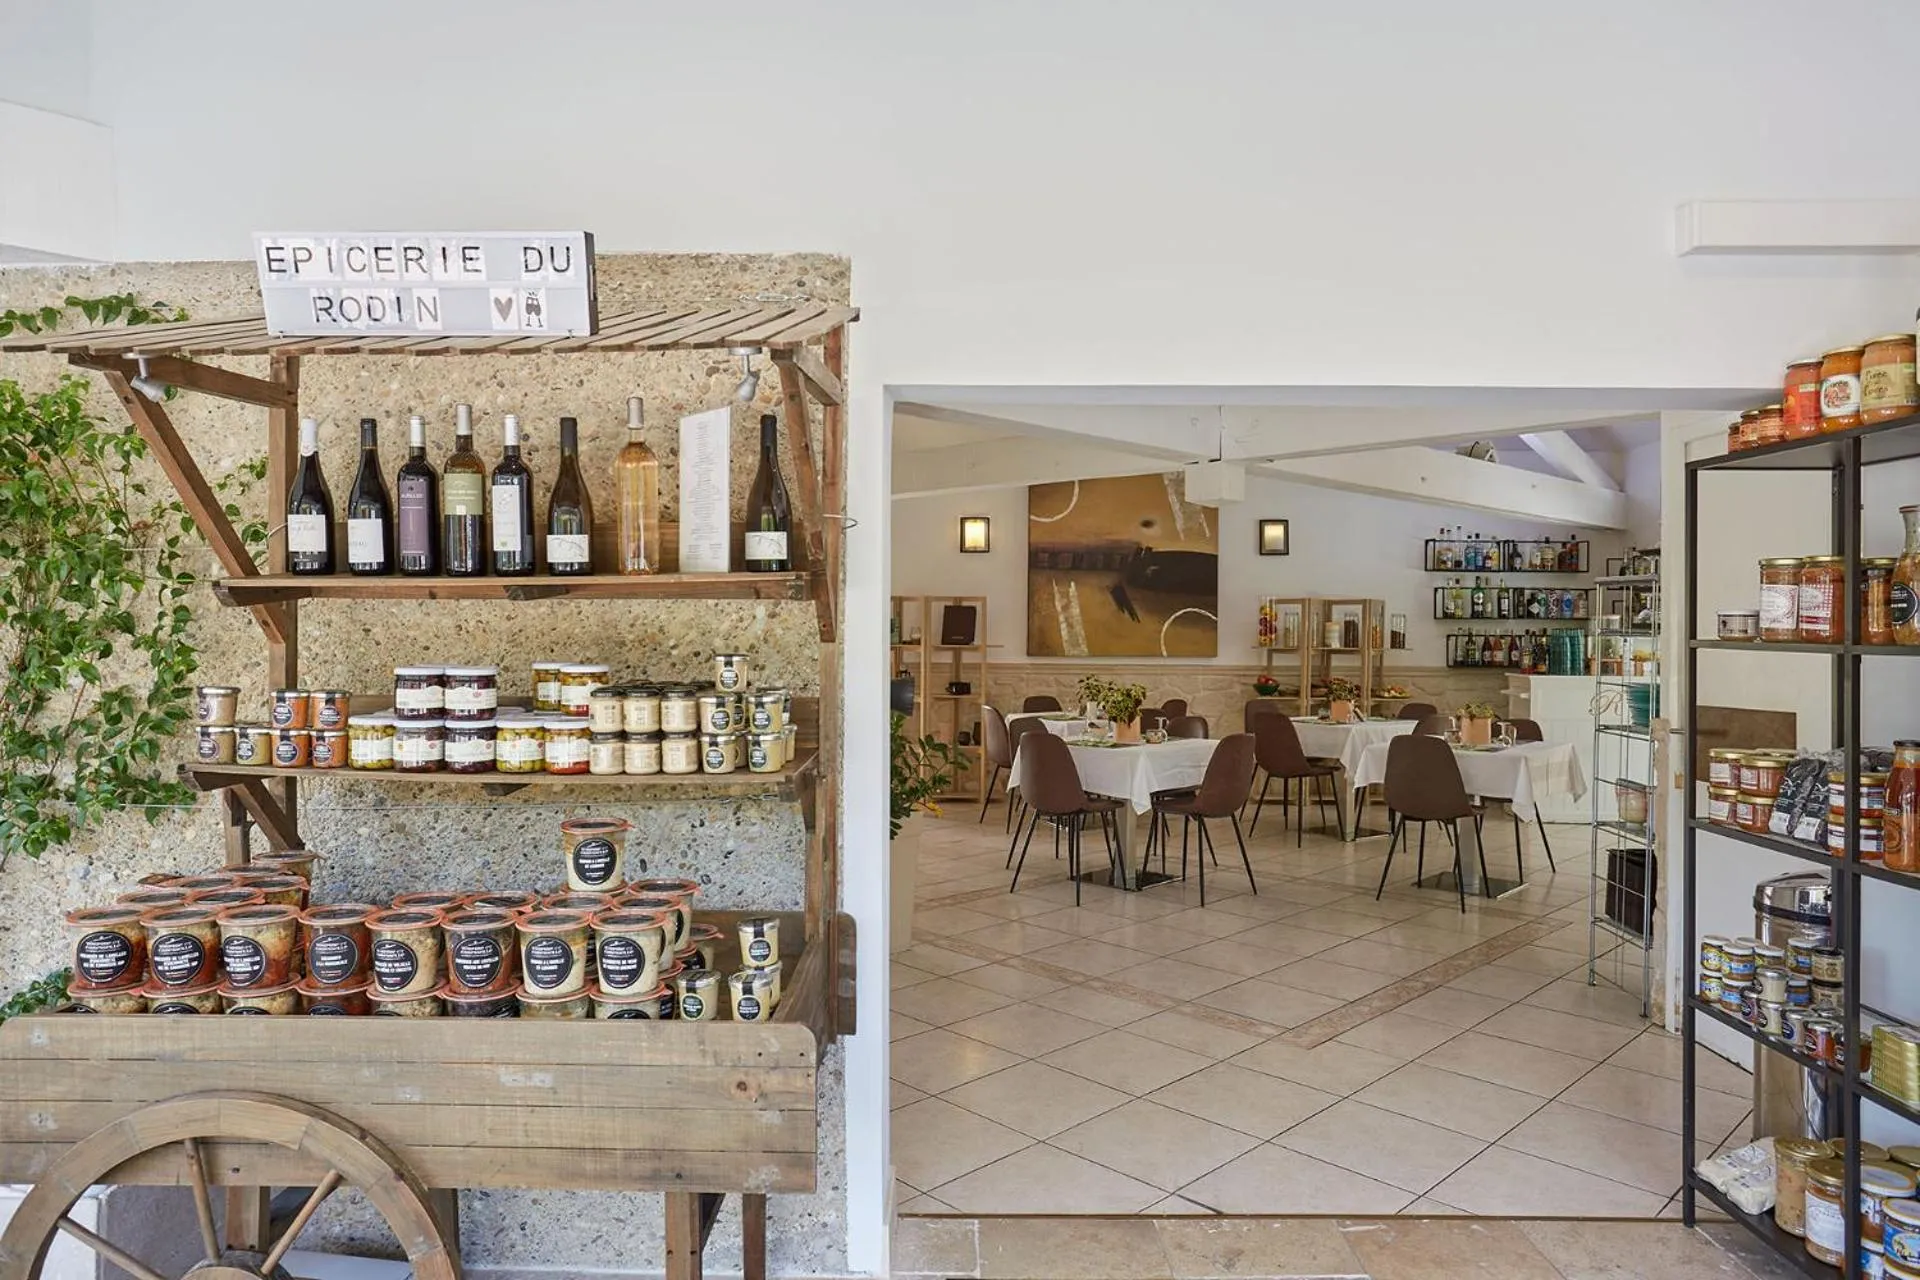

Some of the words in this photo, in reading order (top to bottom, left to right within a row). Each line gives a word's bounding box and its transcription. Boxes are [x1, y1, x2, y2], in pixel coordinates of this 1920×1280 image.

[265, 246, 483, 274] EPICERIE
[523, 245, 571, 274] DU
[312, 295, 440, 323] RODIN
